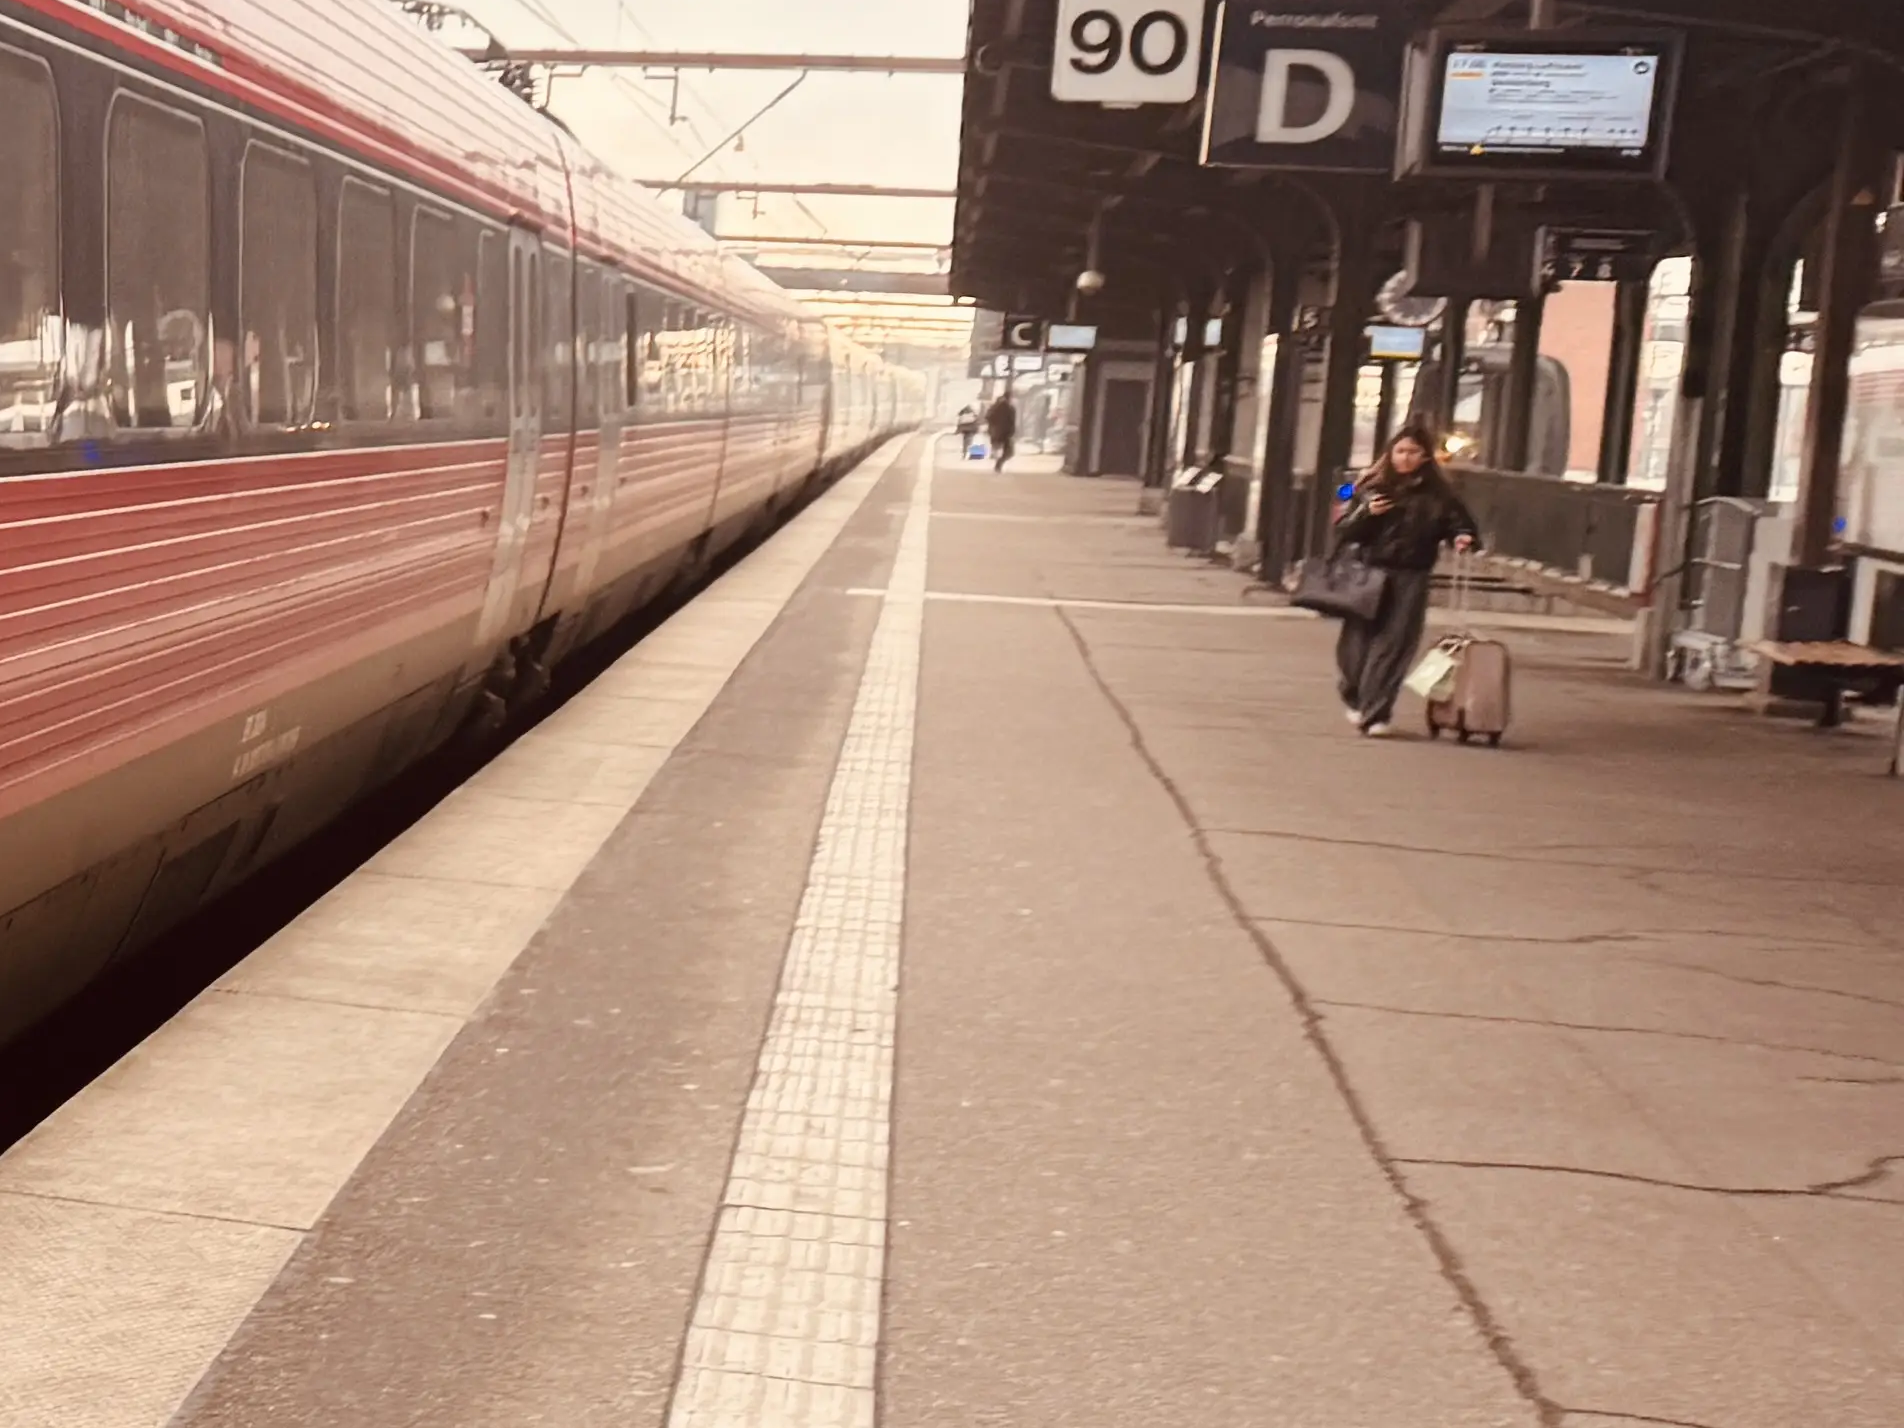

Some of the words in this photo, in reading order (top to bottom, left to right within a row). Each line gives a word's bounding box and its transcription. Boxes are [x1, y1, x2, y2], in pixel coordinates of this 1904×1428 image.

[1070, 9, 1188, 75] 90
[1255, 48, 1355, 144] D
[1011, 322, 1033, 346] C
